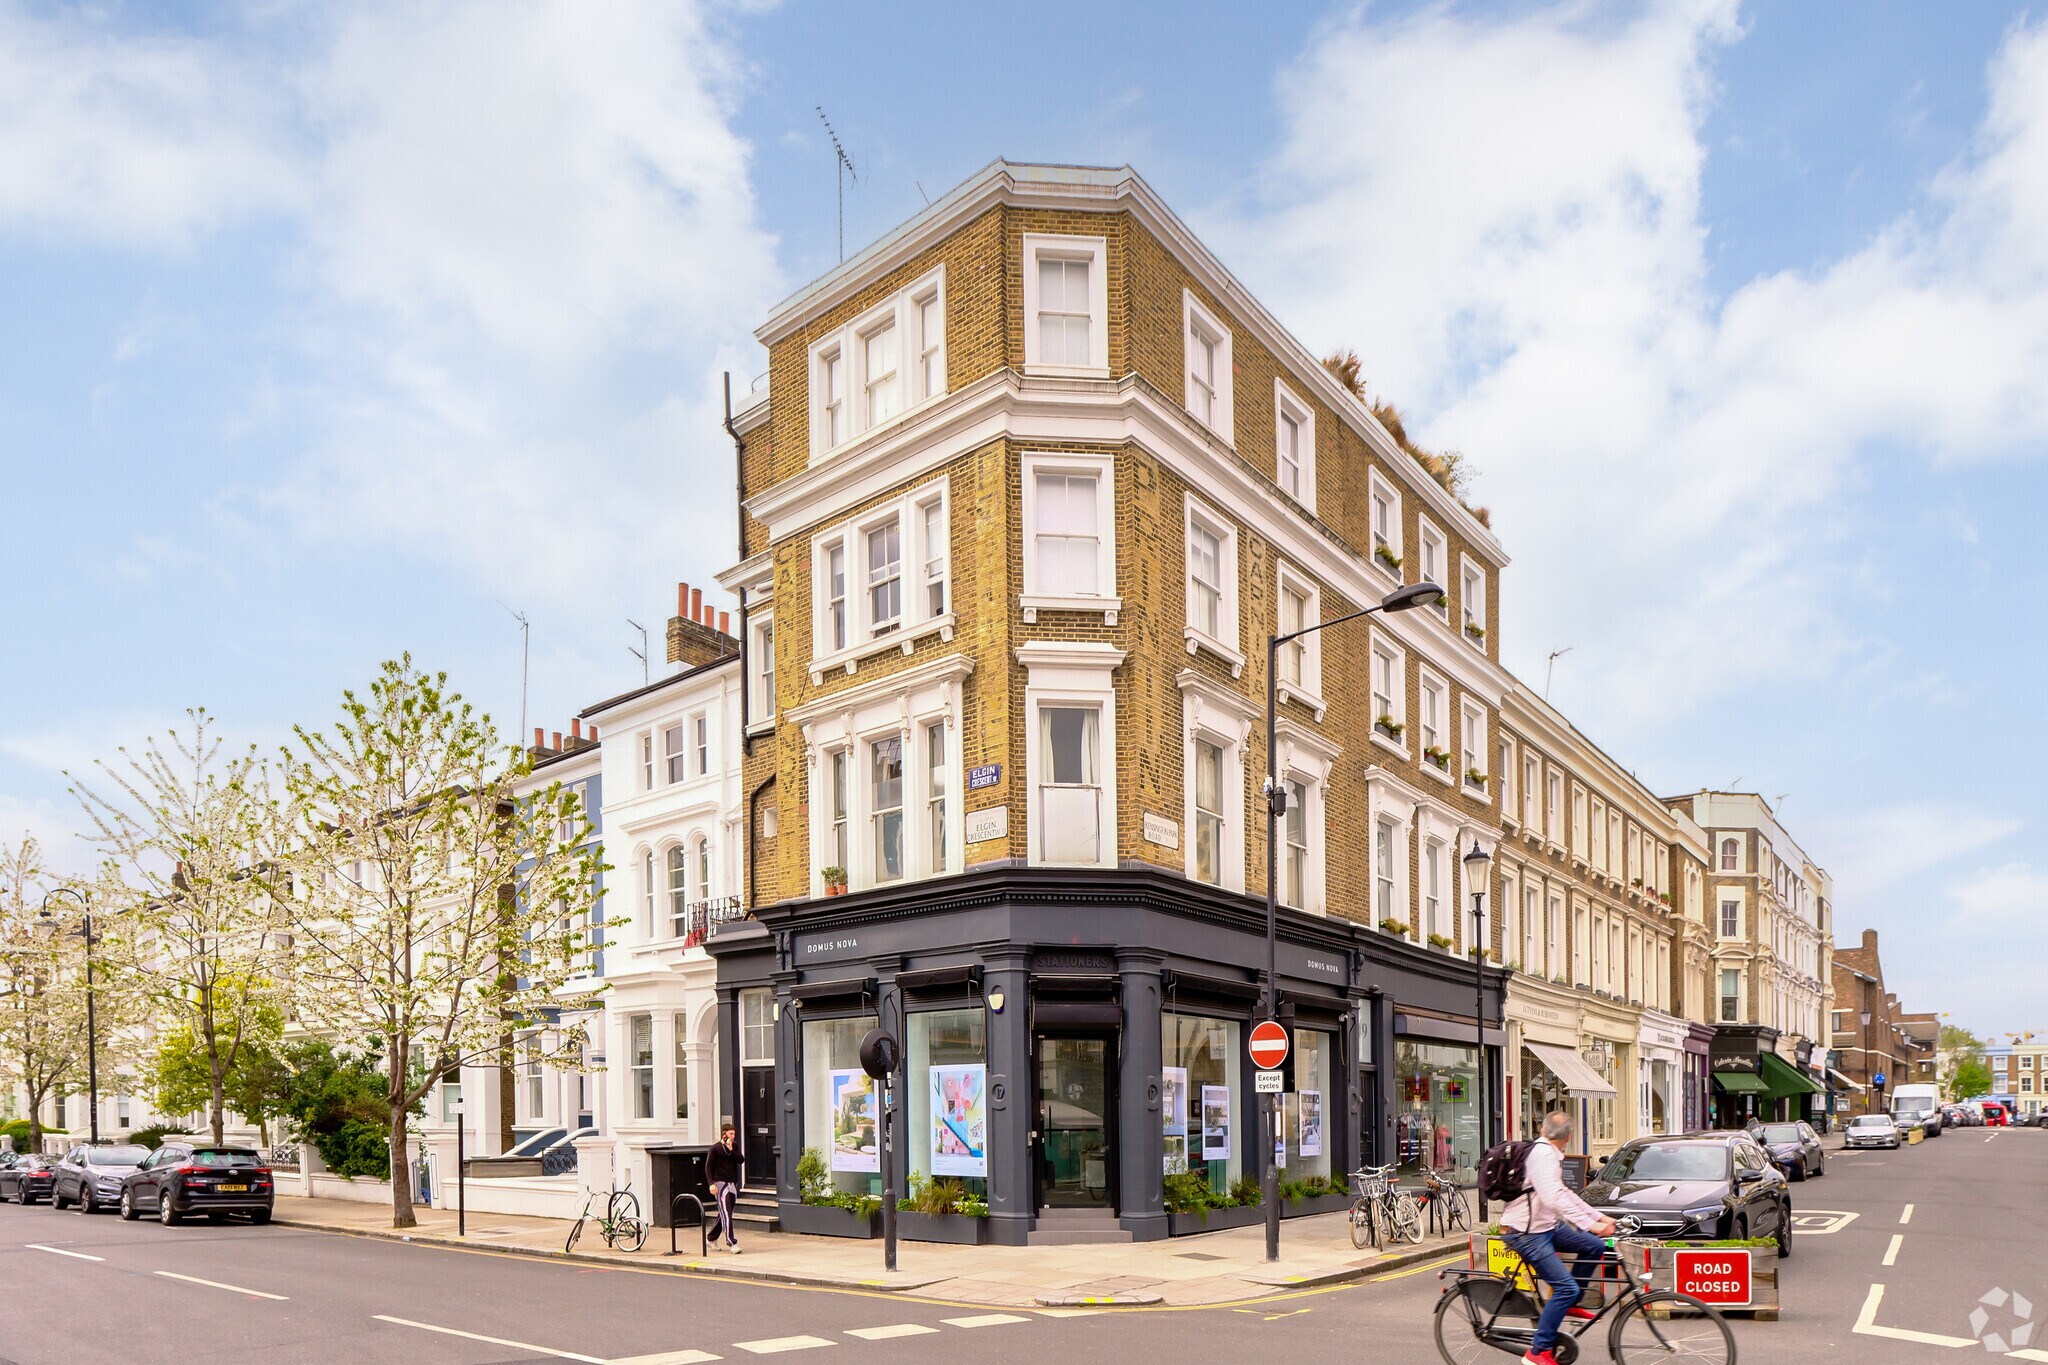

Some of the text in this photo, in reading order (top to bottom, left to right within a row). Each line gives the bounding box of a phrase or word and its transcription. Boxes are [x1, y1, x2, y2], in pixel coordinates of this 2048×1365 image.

[972, 765, 996, 779] ELGIN
[971, 775, 992, 788] CRESCENT
[976, 821, 997, 832] ELGIN
[967, 829, 995, 842] CRESCENT
[807, 939, 858, 953] DOMUS NOVA
[1037, 955, 1109, 968] STATIONERS
[1307, 959, 1339, 973] DOMUS NOVA
[1258, 1074, 1280, 1083] Except
[1693, 1263, 1732, 1275] ROAD
[1685, 1281, 1741, 1293] CLOSED
